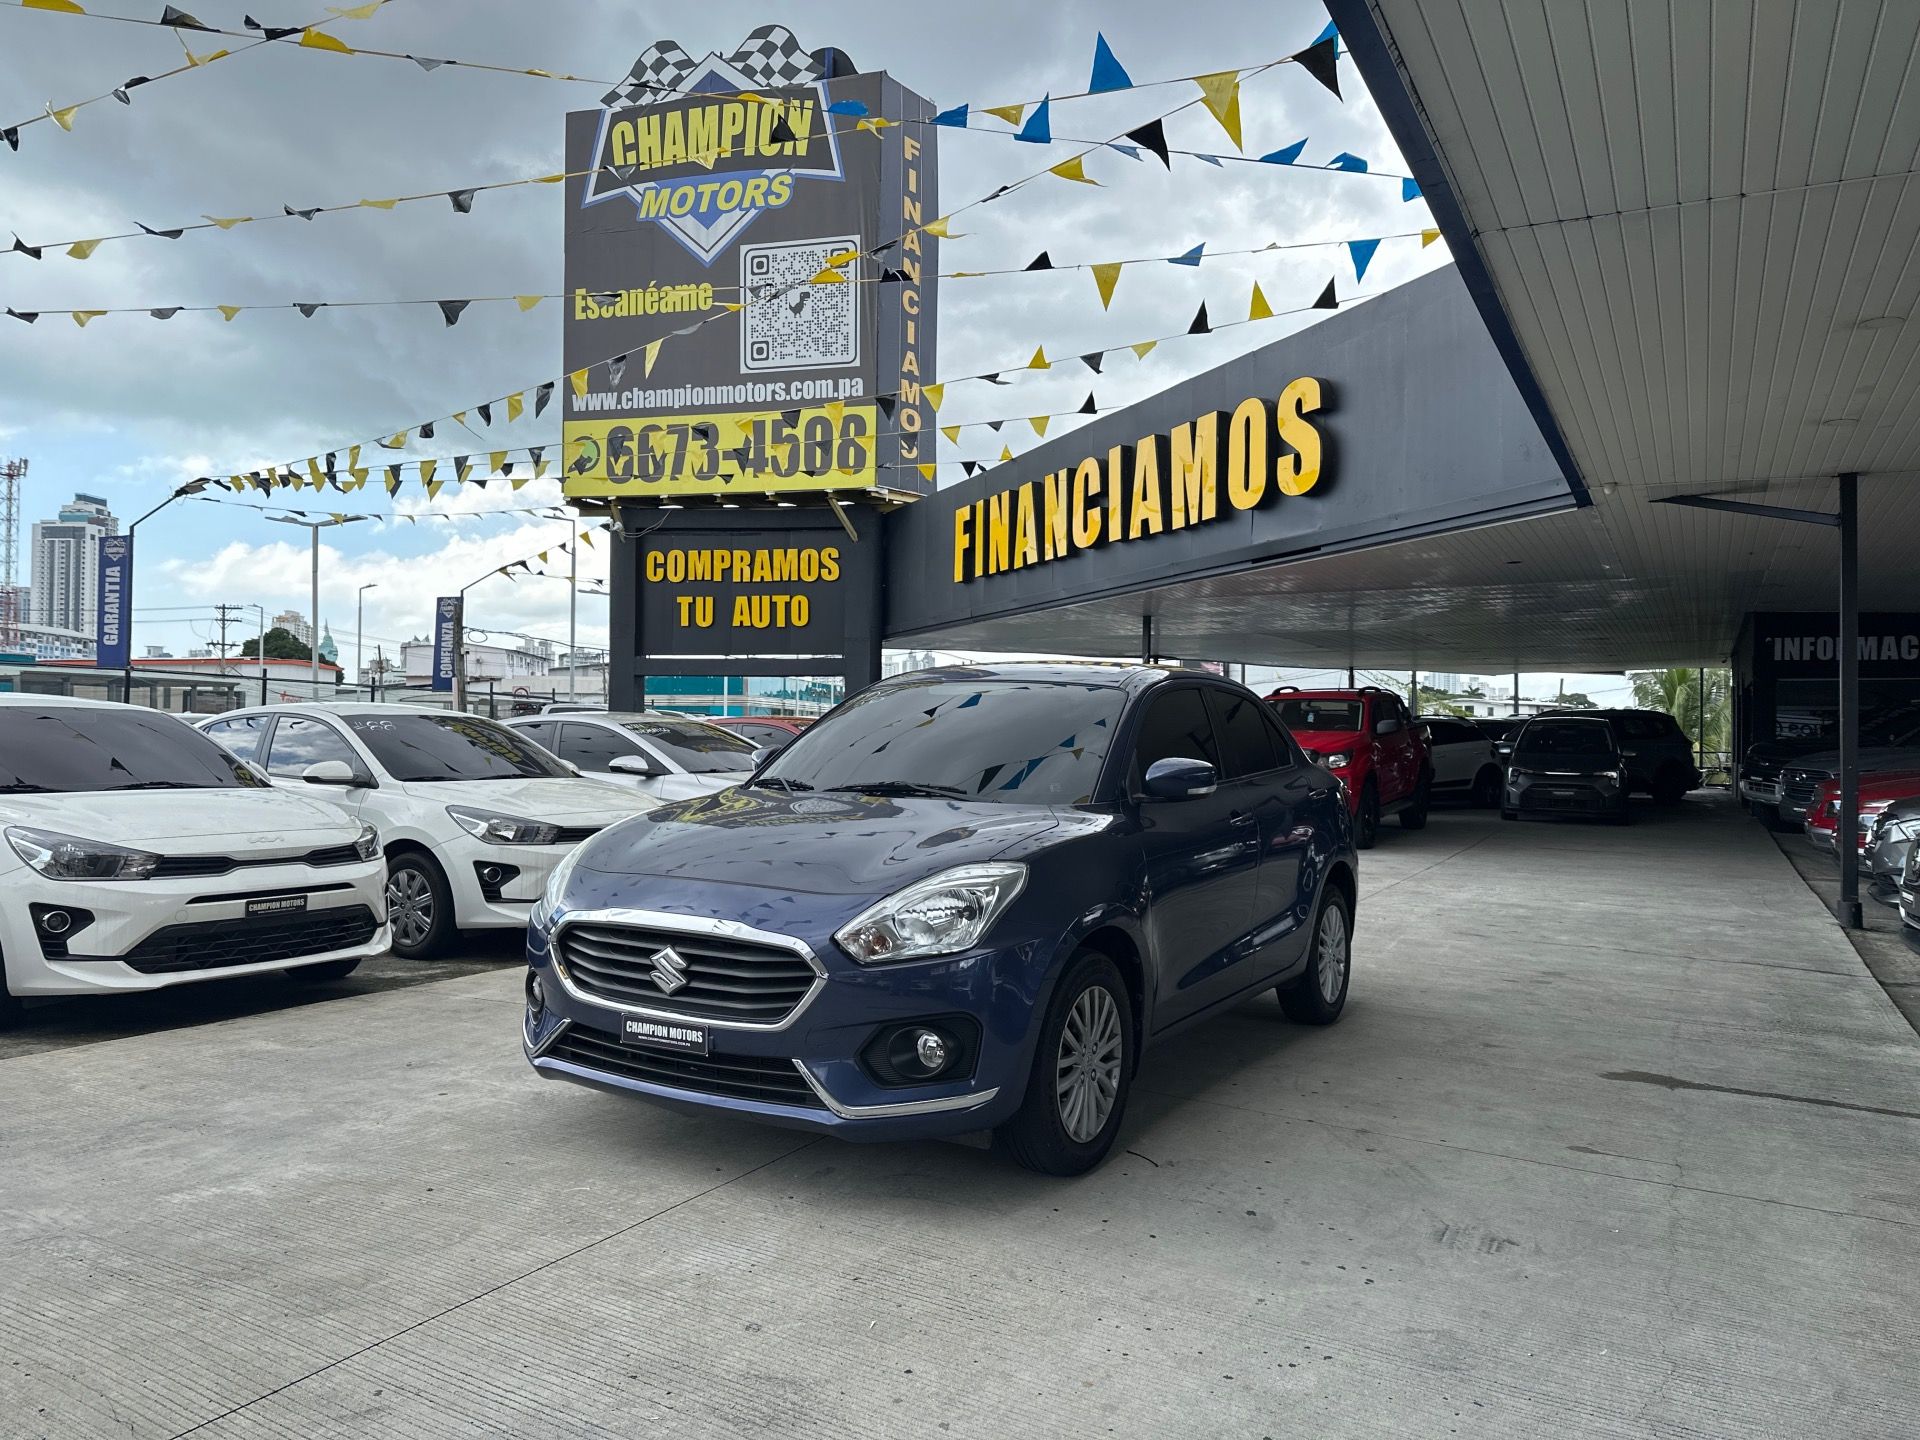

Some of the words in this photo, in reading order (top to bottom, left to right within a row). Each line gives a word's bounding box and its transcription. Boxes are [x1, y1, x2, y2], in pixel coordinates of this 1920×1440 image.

[611, 99, 815, 171] CHAMPION
[639, 175, 793, 219] MOTORS
[574, 281, 714, 321] Escanéame
[571, 377, 865, 412] www.championmotors.com.pa
[606, 413, 867, 484] 6673-4508
[953, 376, 1326, 583] FINANCIAMOS
[646, 547, 840, 583] COMPRAMOS
[103, 565, 121, 646] GARANTIA
[676, 596, 715, 628] TU
[731, 595, 810, 628] AUTO
[440, 621, 454, 678] CONFIANZA
[249, 901, 280, 911] CHAMPION
[281, 899, 304, 908] MOTORS
[626, 1021, 668, 1037] CHAMPION
[669, 1027, 703, 1043] MOTORS
